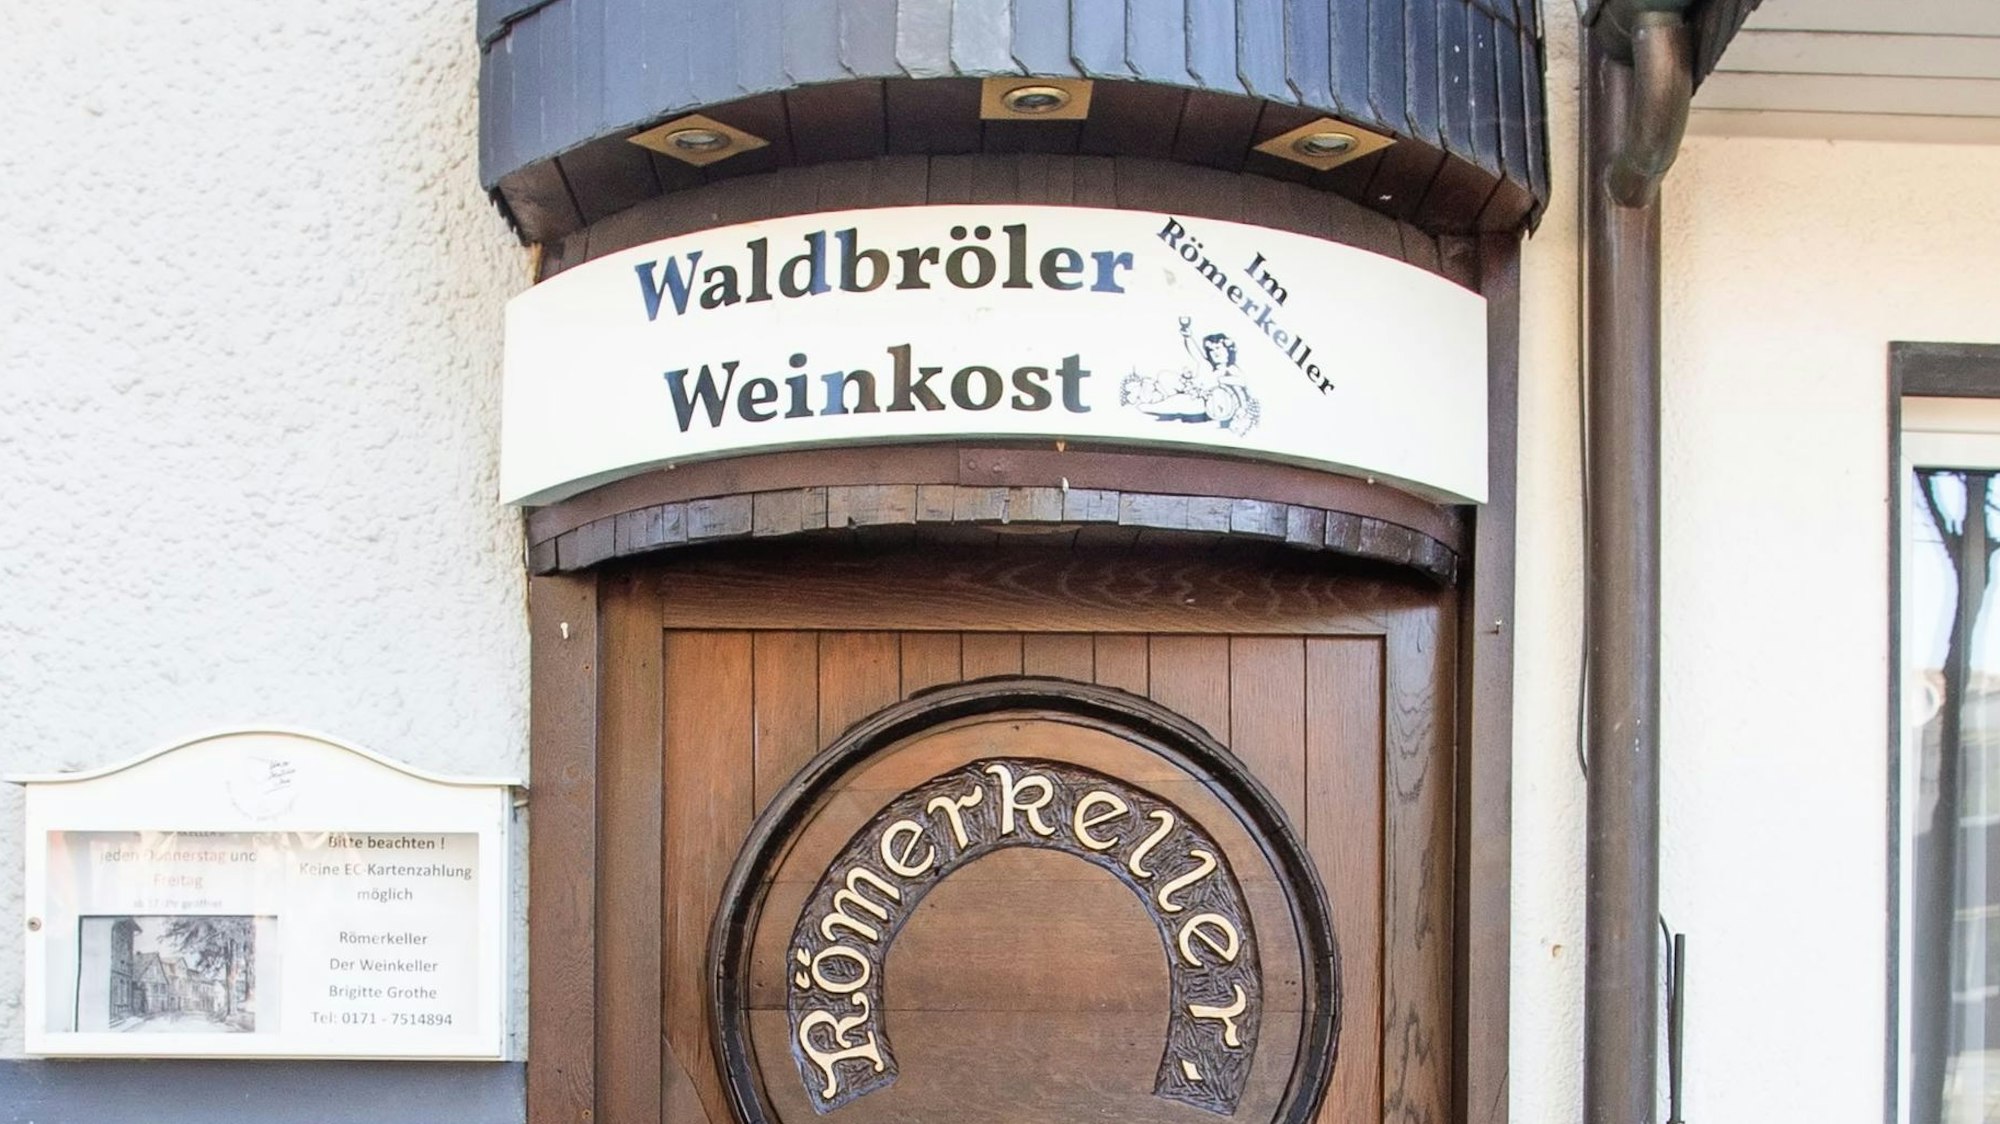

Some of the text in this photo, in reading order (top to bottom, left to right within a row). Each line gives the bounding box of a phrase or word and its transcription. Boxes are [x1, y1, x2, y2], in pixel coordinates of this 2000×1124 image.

[634, 223, 1134, 321] Waldbröler
[1244, 251, 1288, 307] Im
[1157, 216, 1335, 396] Römerkeller
[664, 342, 1092, 432] Weinkost
[328, 836, 363, 849] Bitte
[367, 836, 435, 849] beachten
[299, 863, 340, 876] Keine
[357, 888, 413, 903] möglich
[339, 931, 427, 945] Römerkeller
[329, 958, 438, 972] Der Weinkeller
[329, 985, 437, 1000] Brigitte Grothe
[342, 1012, 376, 1025] 0171
[392, 1013, 453, 1026] 7514894
